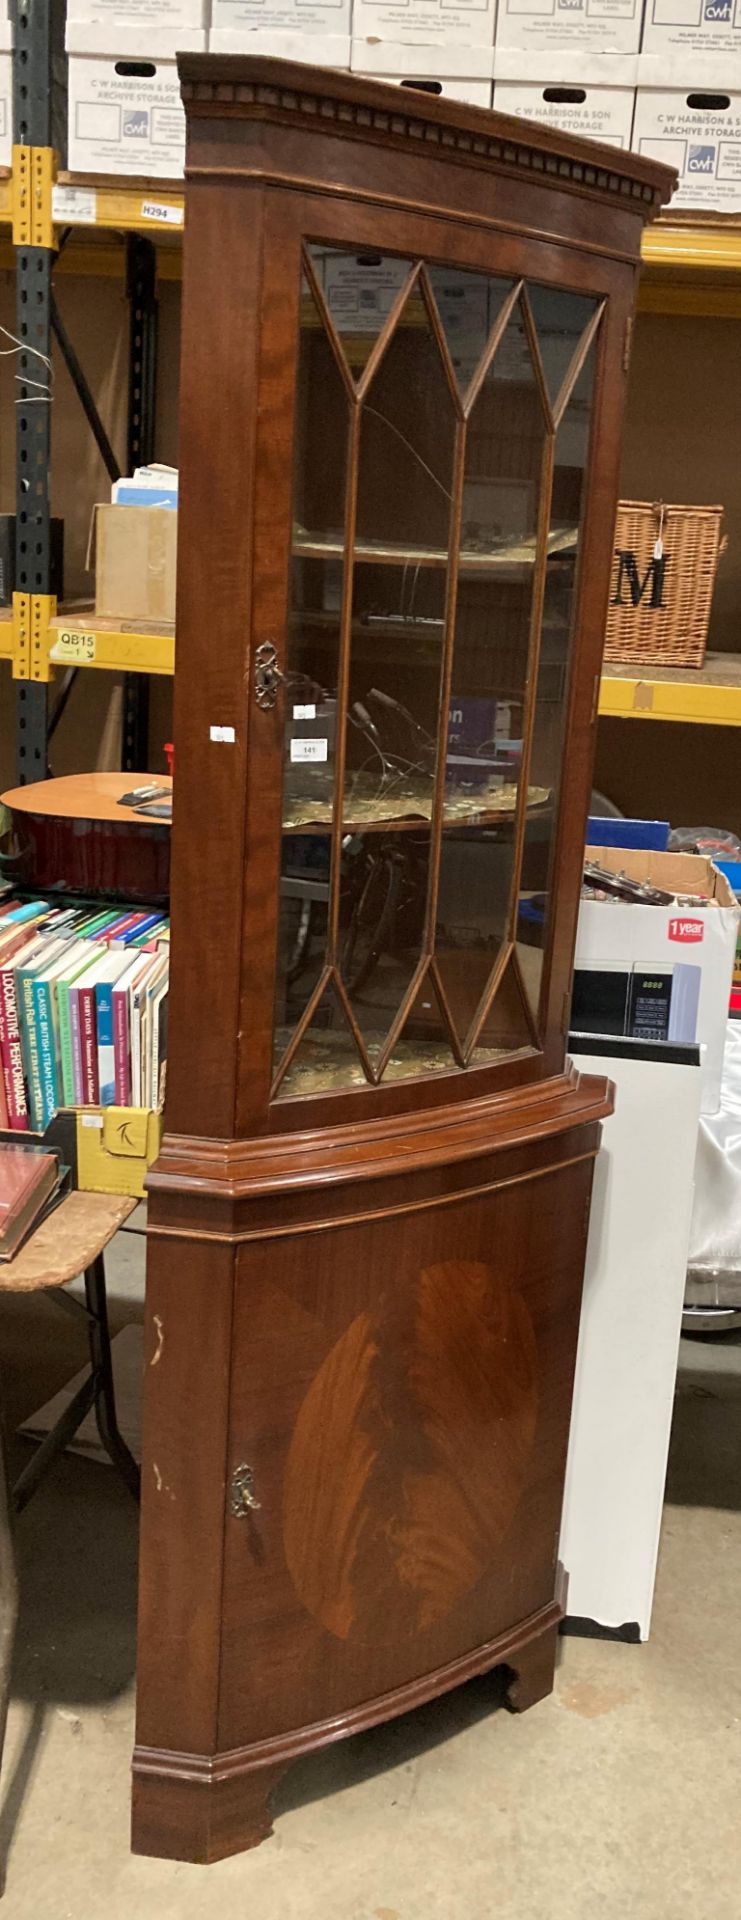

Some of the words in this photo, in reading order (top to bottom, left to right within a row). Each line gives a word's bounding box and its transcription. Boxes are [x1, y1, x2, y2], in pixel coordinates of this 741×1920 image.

[110, 80, 154, 91] HARRISON
[98, 91, 134, 101] ARCHIVE
[136, 93, 176, 104] STORAGE
[536, 108, 581, 118] HARRISON
[658, 114, 664, 122] C
[679, 116, 725, 126] HARRISON
[726, 118, 733, 126] &
[562, 121, 604, 130] STORAGE
[662, 126, 703, 136] ARCHIVE
[143, 205, 168, 218] H294
[608, 550, 672, 608] M
[61, 633, 94, 647] QB15
[670, 920, 678, 936] 1
[679, 922, 704, 936] year
[22, 978, 34, 1008] British
[2, 973, 20, 1039] LOCOMOTIVE
[37, 987, 48, 1020] CLASSIC
[26, 1009, 36, 1026] Rail
[29, 1027, 37, 1048] THE
[40, 1022, 50, 1052] BRITISH
[44, 1053, 52, 1080] STEAM
[10, 1042, 28, 1116] PERFORMANCE
